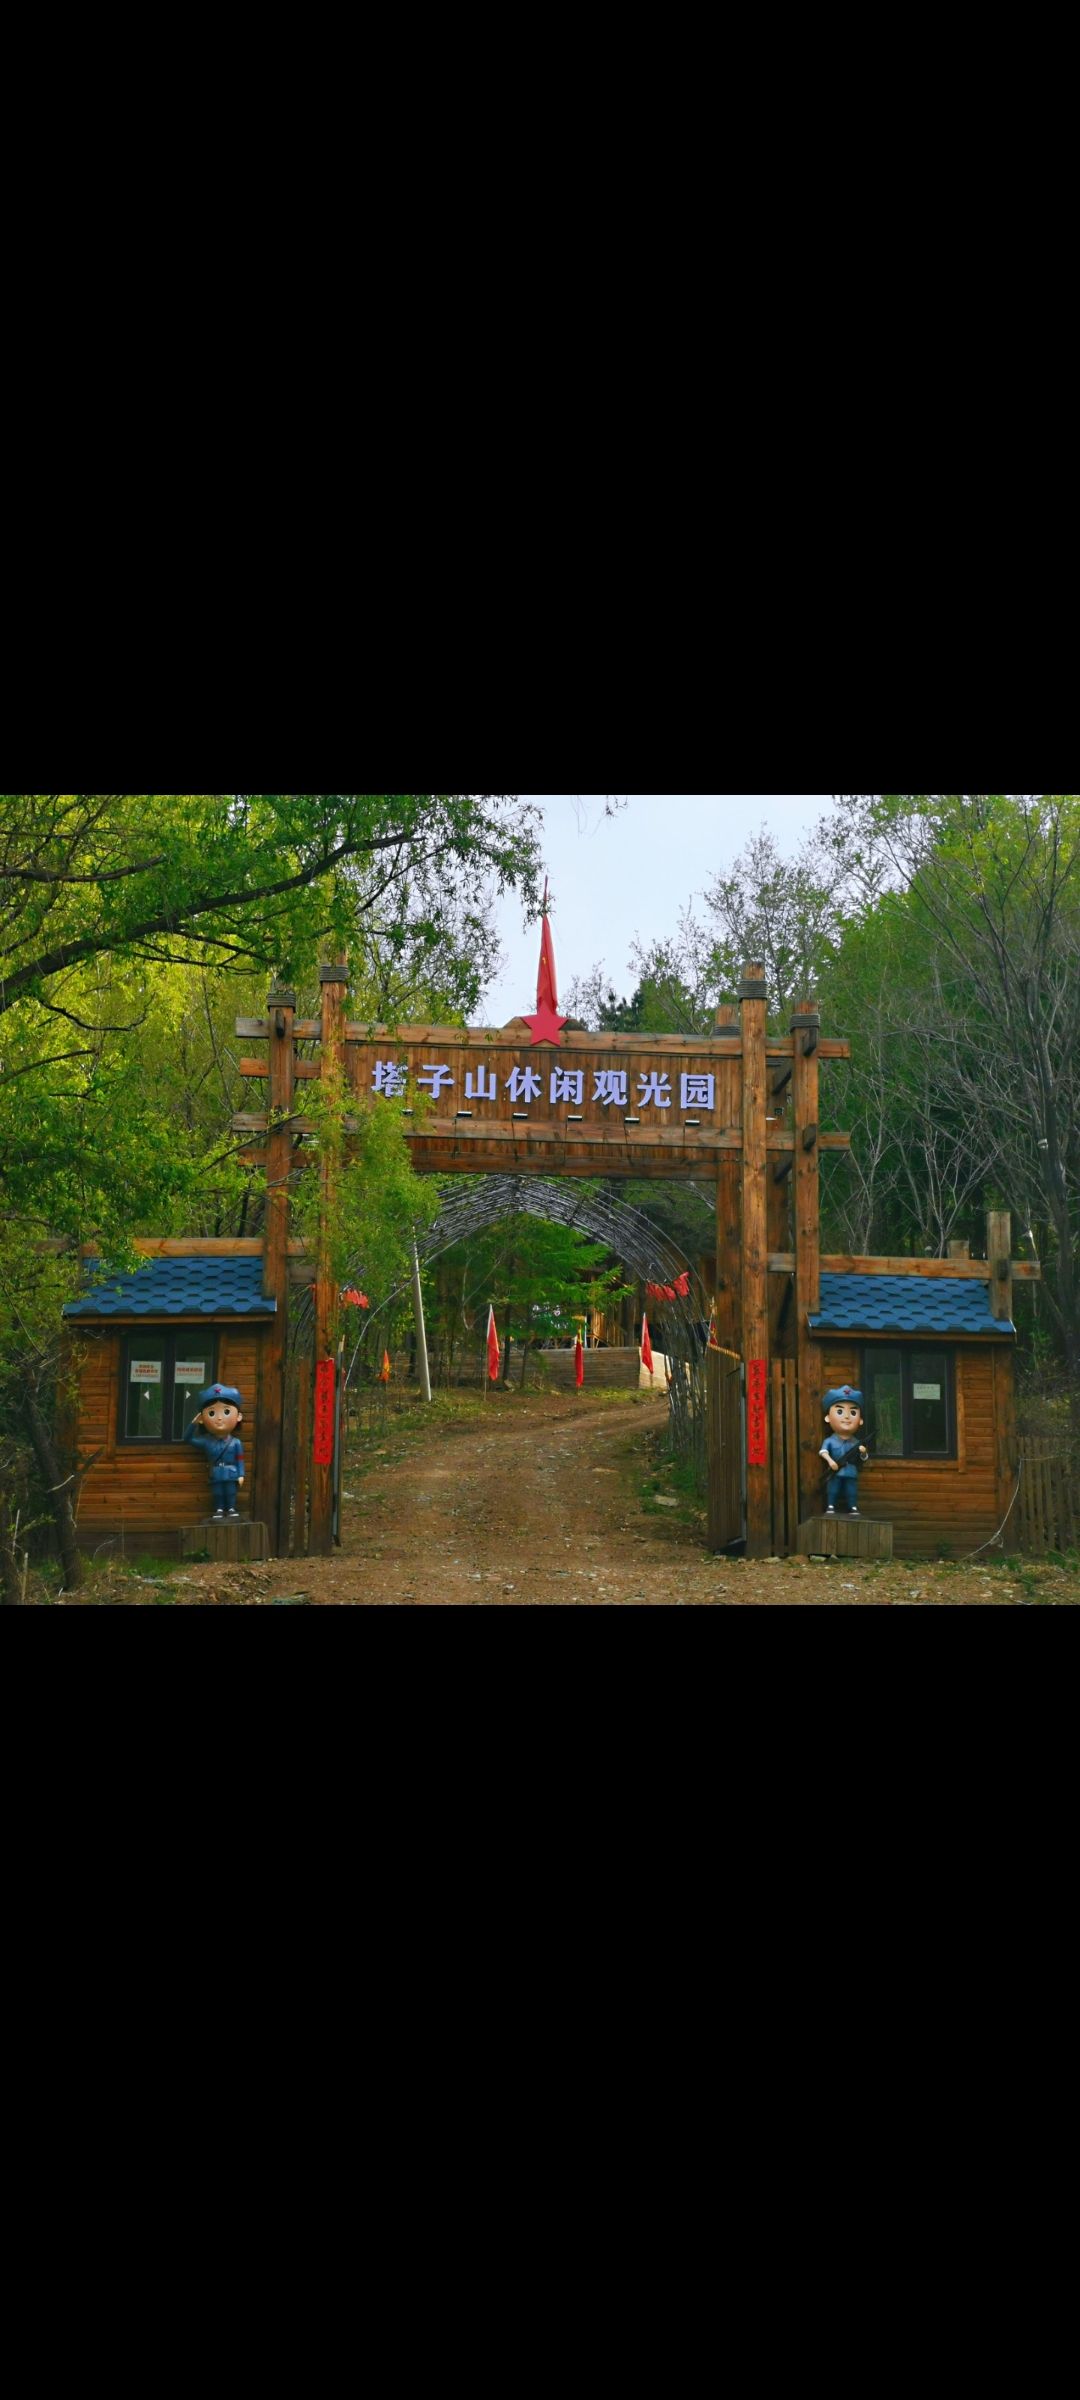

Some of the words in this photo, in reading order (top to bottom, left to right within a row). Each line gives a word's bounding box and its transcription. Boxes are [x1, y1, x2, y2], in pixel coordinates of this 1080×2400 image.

[371, 1060, 715, 1110] 塔子山休闲观光园
